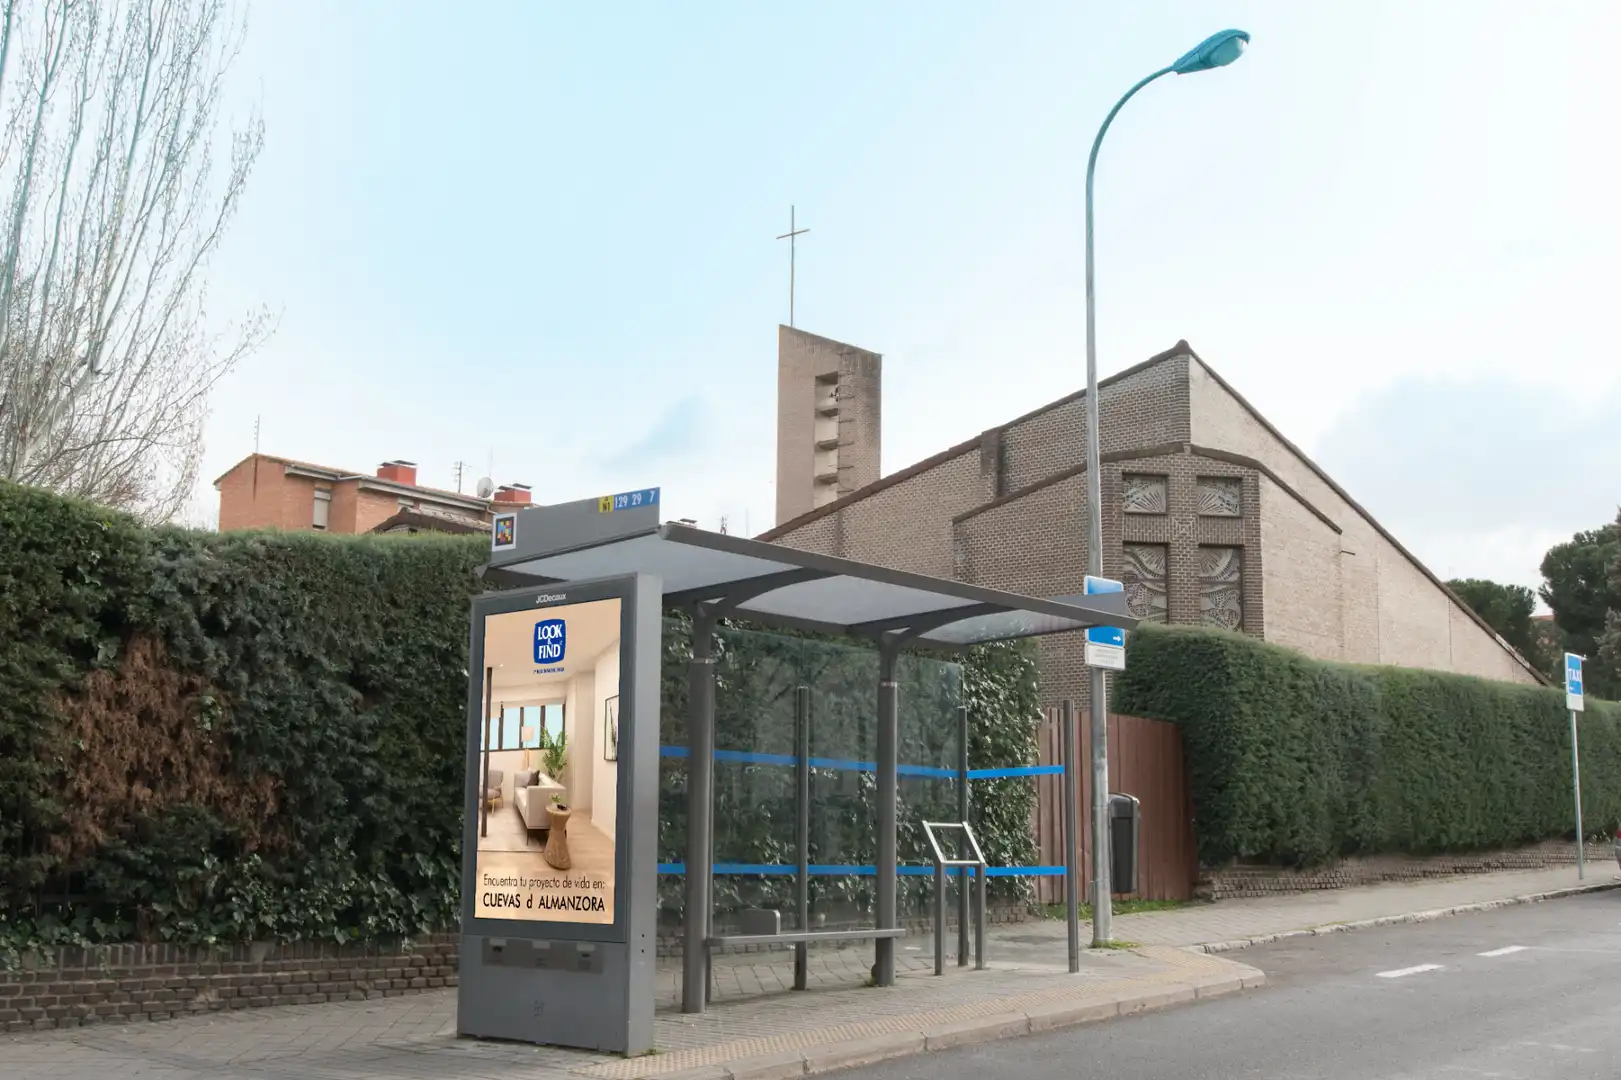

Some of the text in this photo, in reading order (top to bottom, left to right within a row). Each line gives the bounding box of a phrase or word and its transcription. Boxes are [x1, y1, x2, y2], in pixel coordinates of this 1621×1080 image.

[615, 495, 628, 508] 129
[631, 493, 642, 506] 29
[649, 490, 655, 503] 7
[535, 592, 567, 604] JCDecaux
[537, 624, 563, 640] LOOK
[538, 643, 561, 659] FIND
[1568, 668, 1582, 681] TAXI
[483, 873, 606, 891] Encuentra tu proyecto de vida en:
[483, 892, 606, 912] CUEVAS d ALMANZORA
